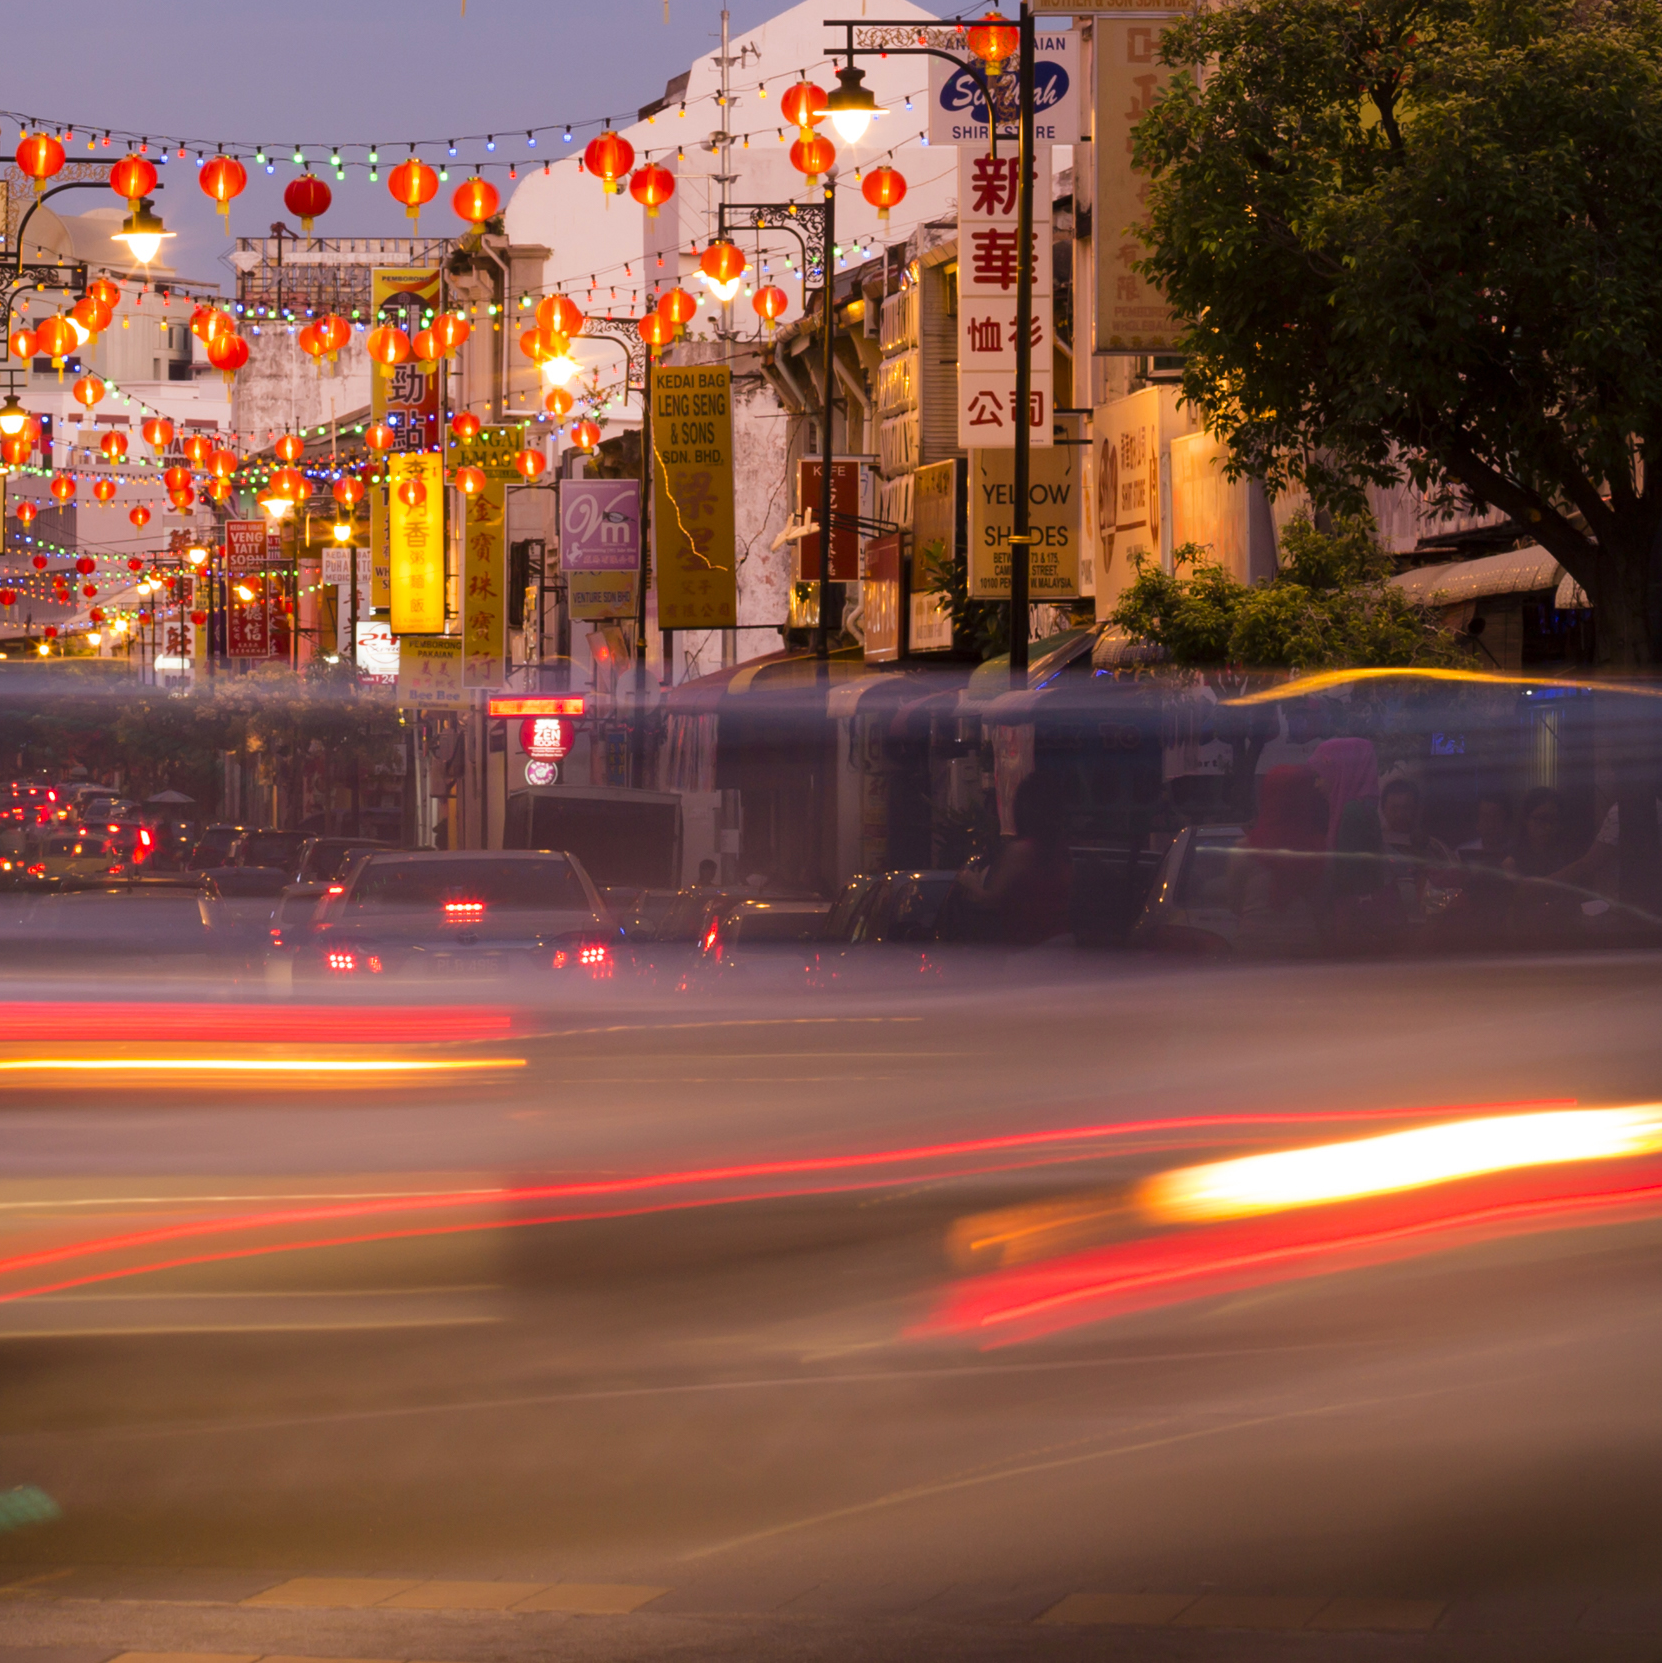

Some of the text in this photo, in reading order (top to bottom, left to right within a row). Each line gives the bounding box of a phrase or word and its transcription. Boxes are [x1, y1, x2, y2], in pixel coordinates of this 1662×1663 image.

[1004, 126, 1056, 139] STRE
[656, 373, 725, 389] KEDAI BAG
[657, 393, 726, 417] LENG SENG
[670, 422, 715, 446] & SONS
[662, 449, 724, 464] SDN. BHD.
[813, 465, 846, 477] KFE
[982, 483, 1072, 505] YELOW
[230, 532, 264, 543] VENG
[984, 525, 1069, 547] SHDES
[234, 543, 260, 554] TATT
[325, 573, 361, 582] MEDICL
[572, 591, 602, 604] VENTURE
[603, 591, 617, 602] SDN
[409, 639, 462, 650] PEMBORONG
[417, 650, 454, 659] PAKAIAN
[533, 728, 561, 741] ZEN
